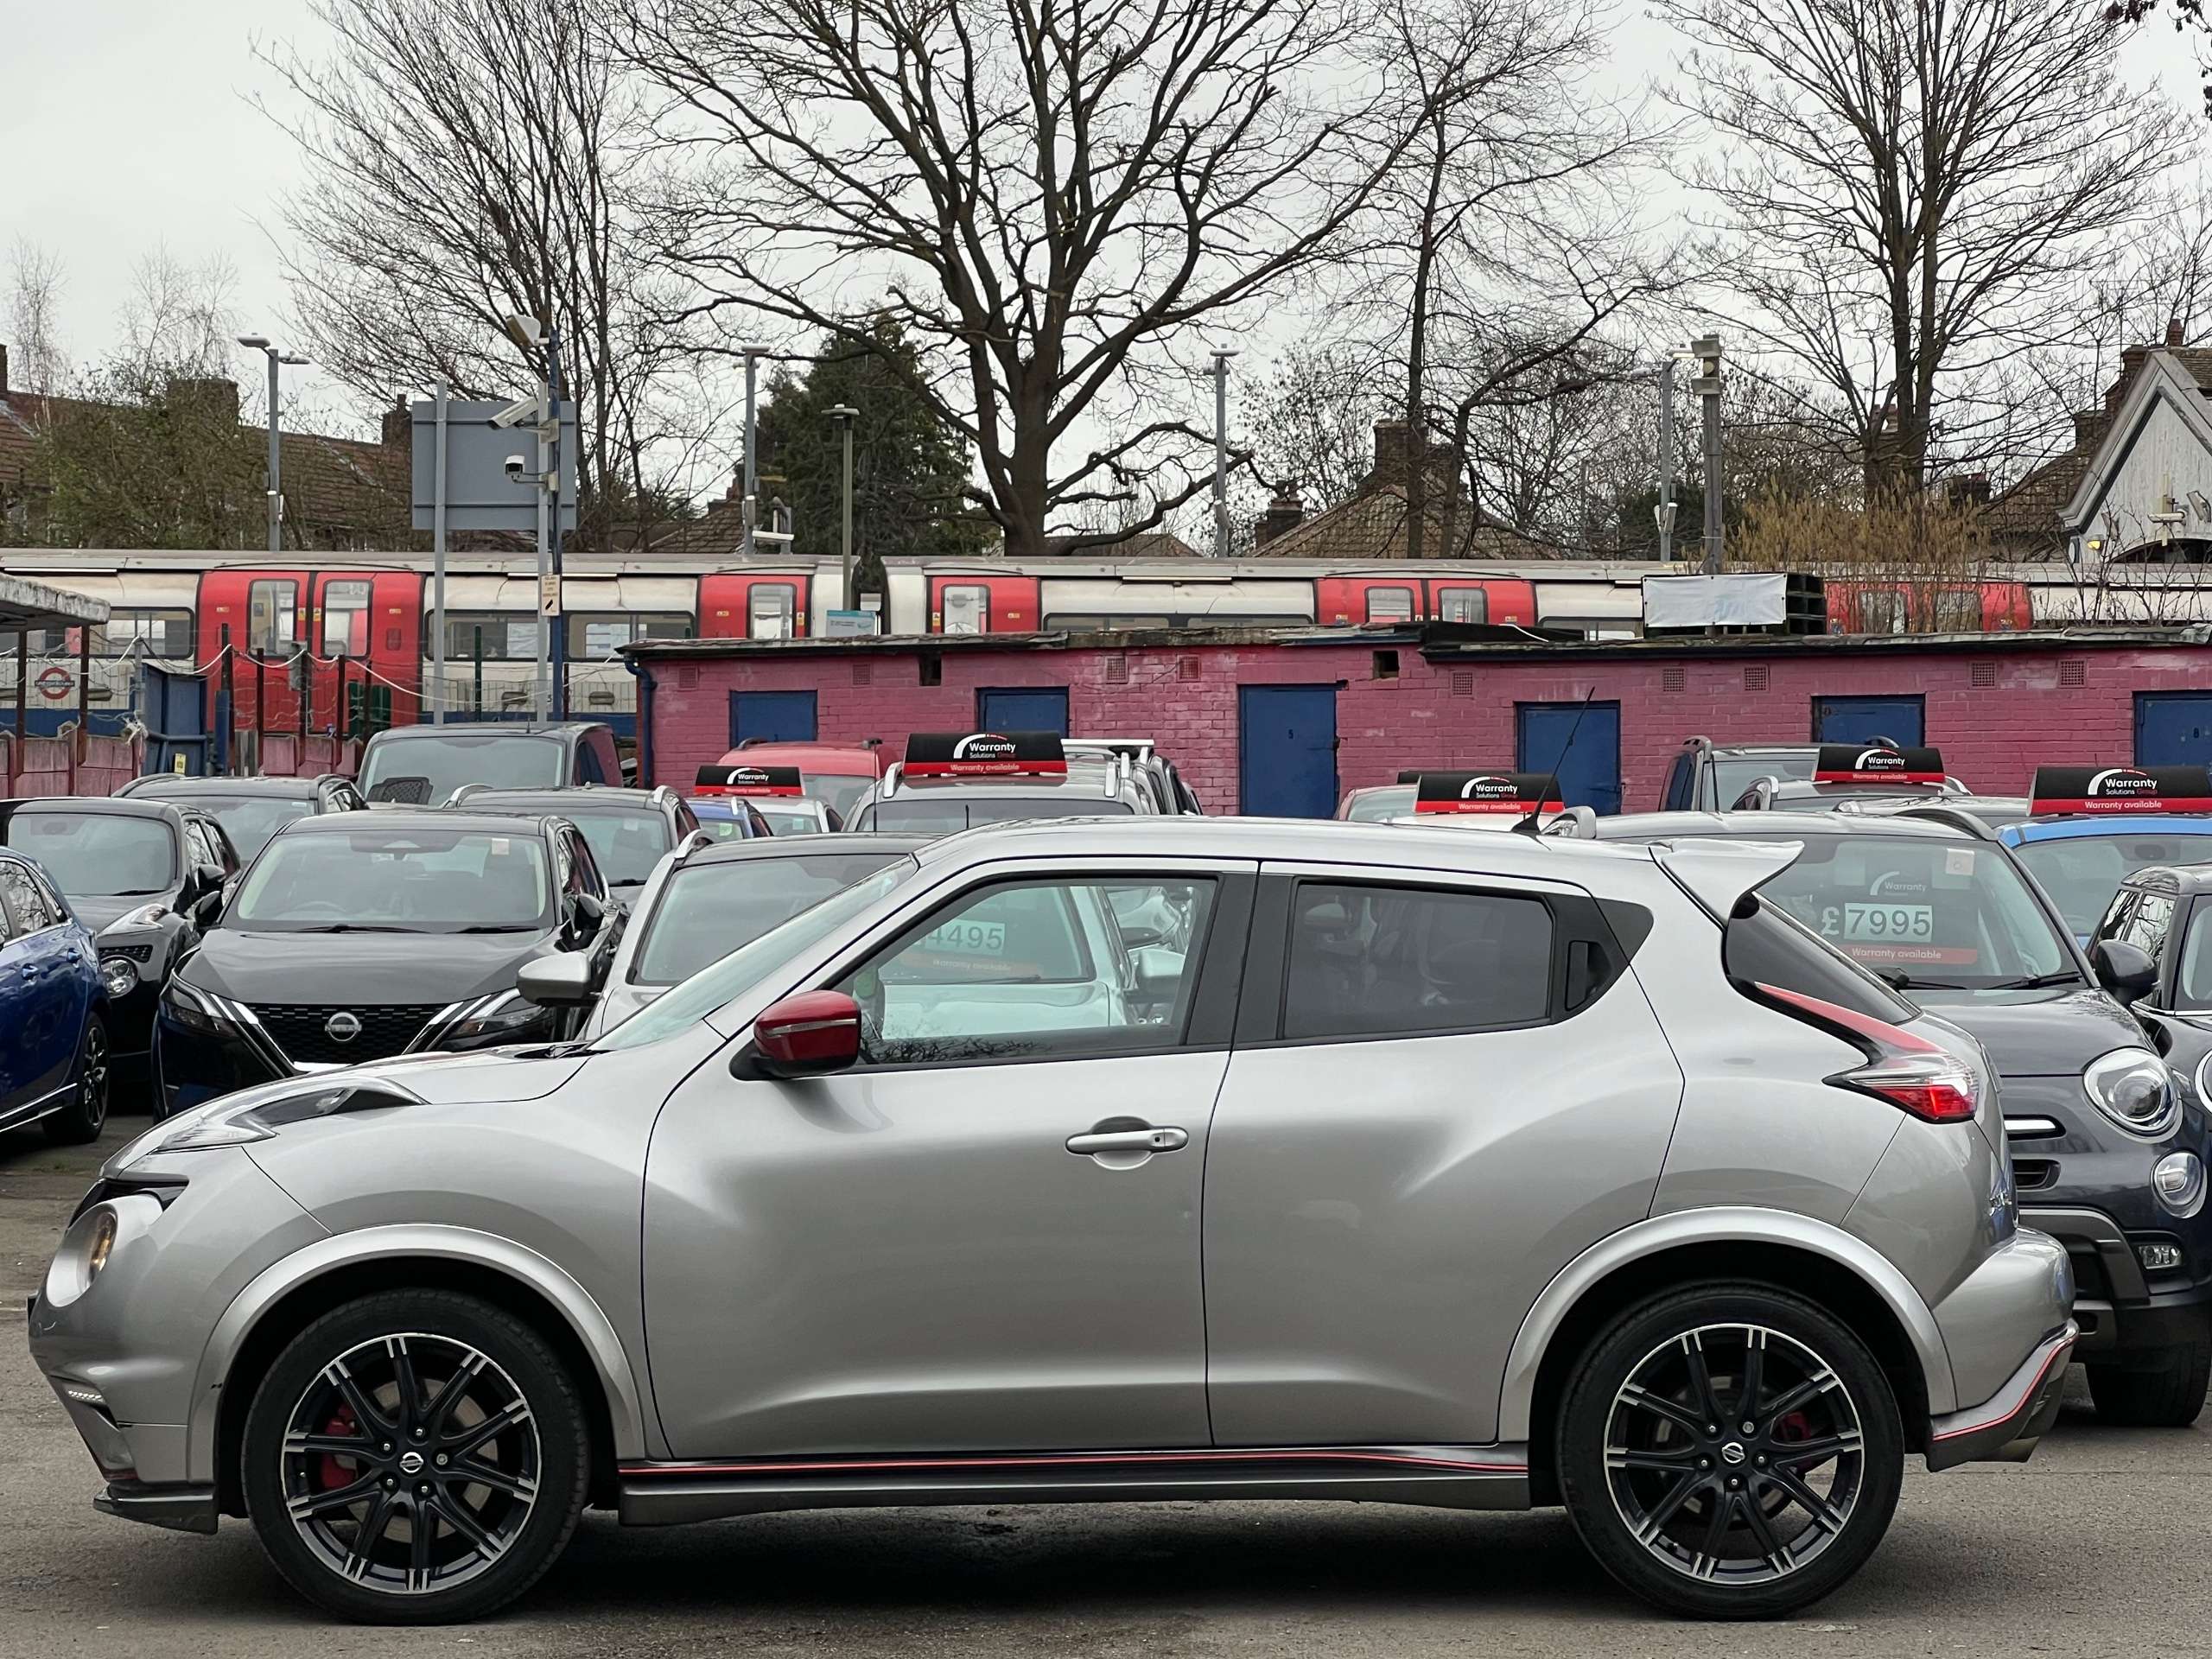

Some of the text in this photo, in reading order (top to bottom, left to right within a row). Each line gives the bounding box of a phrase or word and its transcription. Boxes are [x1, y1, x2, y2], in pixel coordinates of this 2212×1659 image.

[969, 742, 1016, 753] Warranty
[1867, 757, 1905, 766] Warranty
[950, 764, 984, 772] Warranty
[738, 773, 769, 782] Warranty
[1475, 784, 1518, 794] Warranty
[2105, 779, 2158, 790] Warranty
[2085, 801, 2122, 810] Warranty
[1885, 881, 1927, 893] Warranty
[1852, 947, 1942, 959] Warranty available
